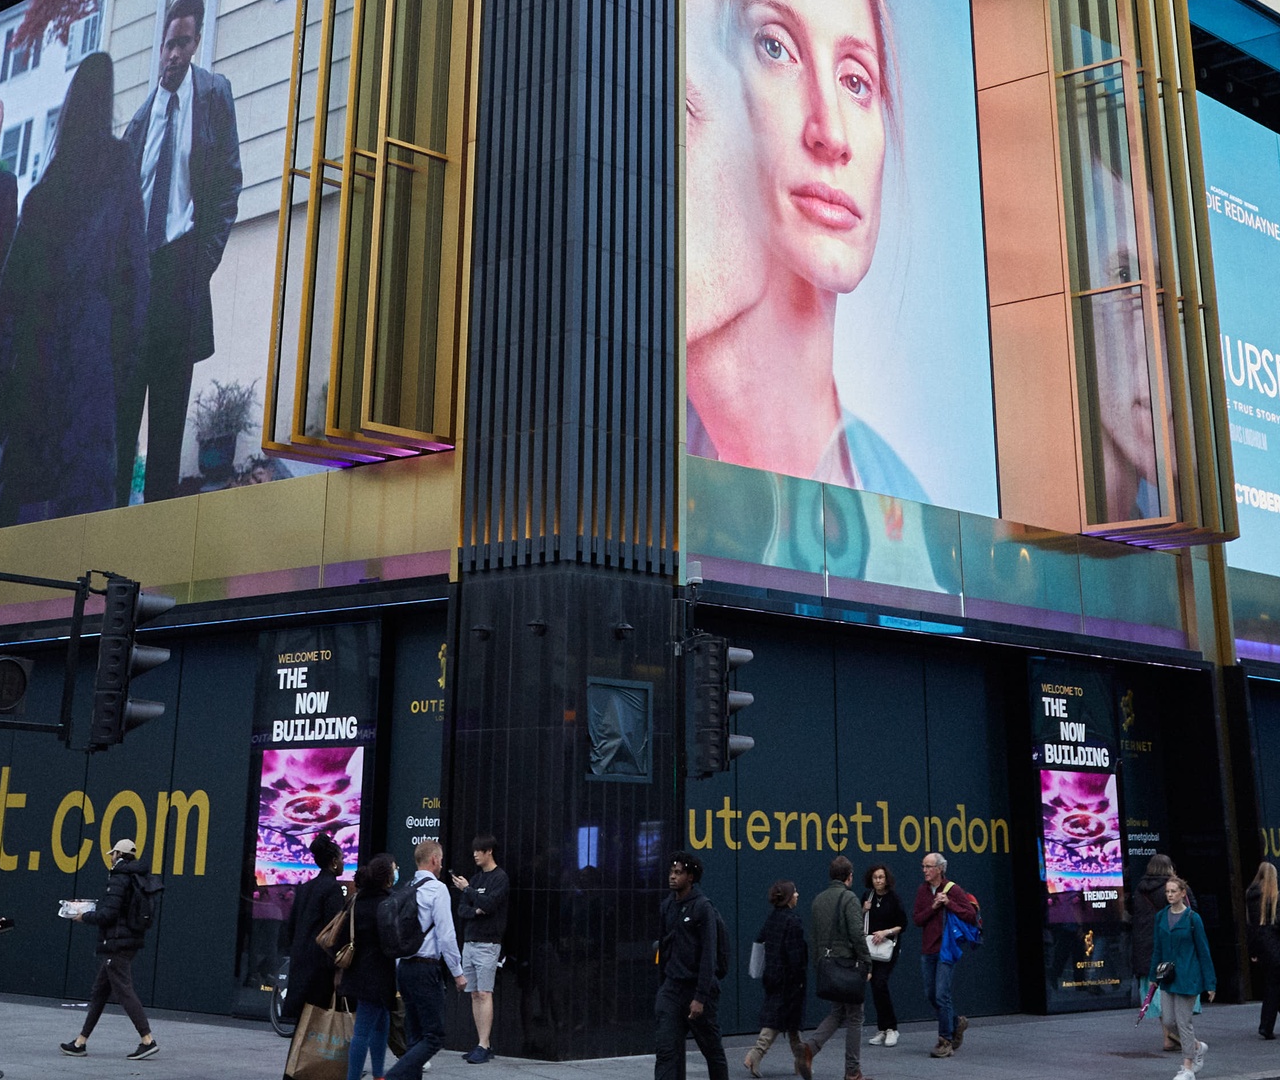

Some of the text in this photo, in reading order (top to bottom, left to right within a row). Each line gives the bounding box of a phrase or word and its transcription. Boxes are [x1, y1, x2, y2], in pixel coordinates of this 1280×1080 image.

[1233, 400, 1253, 416] TRUE
[1256, 406, 1280, 424] STORY
[278, 650, 332, 664] WELCOME TO
[277, 667, 308, 689] THE
[1041, 683, 1084, 697] WELCOME TO
[295, 691, 329, 714] NOW
[1042, 697, 1068, 718] THE
[272, 716, 358, 742] BUILDING
[1060, 721, 1086, 742] NOW
[1044, 744, 1110, 767] BUILDING
[689, 797, 1010, 854] uternetlondon
[1083, 890, 1118, 901] TRENDING
